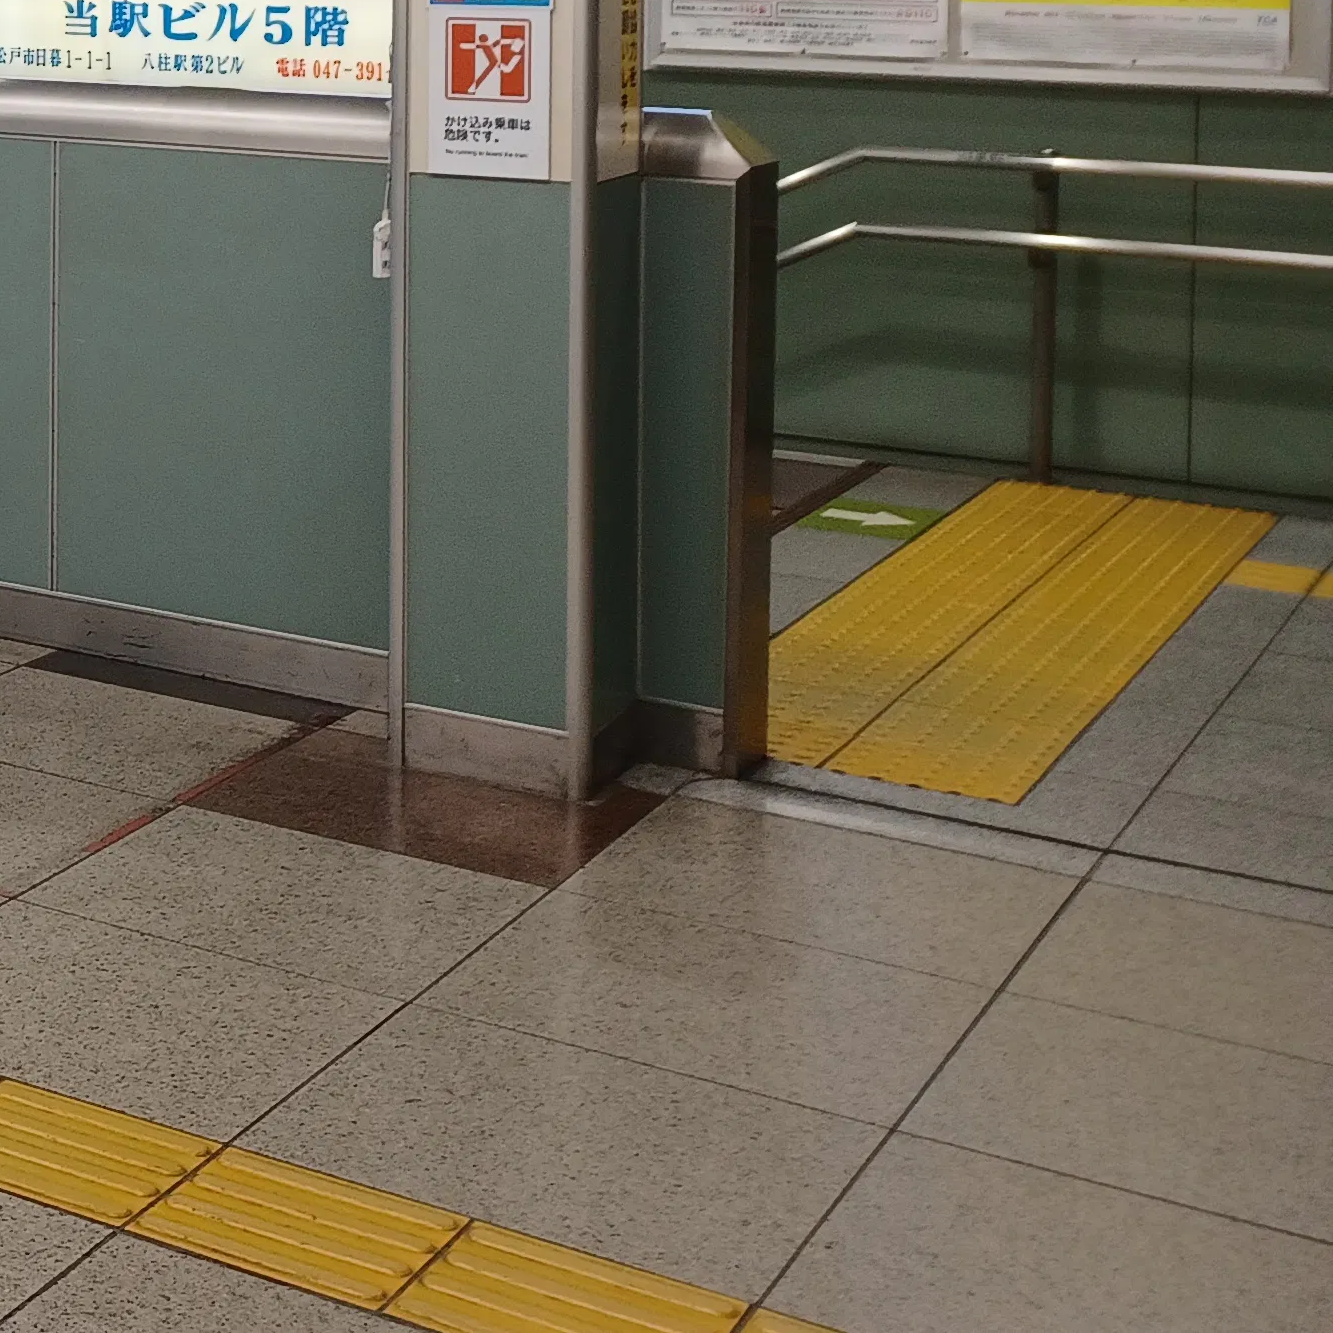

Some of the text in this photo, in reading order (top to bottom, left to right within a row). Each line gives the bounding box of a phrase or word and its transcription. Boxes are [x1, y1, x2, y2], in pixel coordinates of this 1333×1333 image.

[141, 52, 245, 76] 八柱駅第2ビル
[275, 57, 307, 79] 電話
[444, 116, 531, 131] かけ込み乗車は
[444, 128, 500, 143] 危険です。
